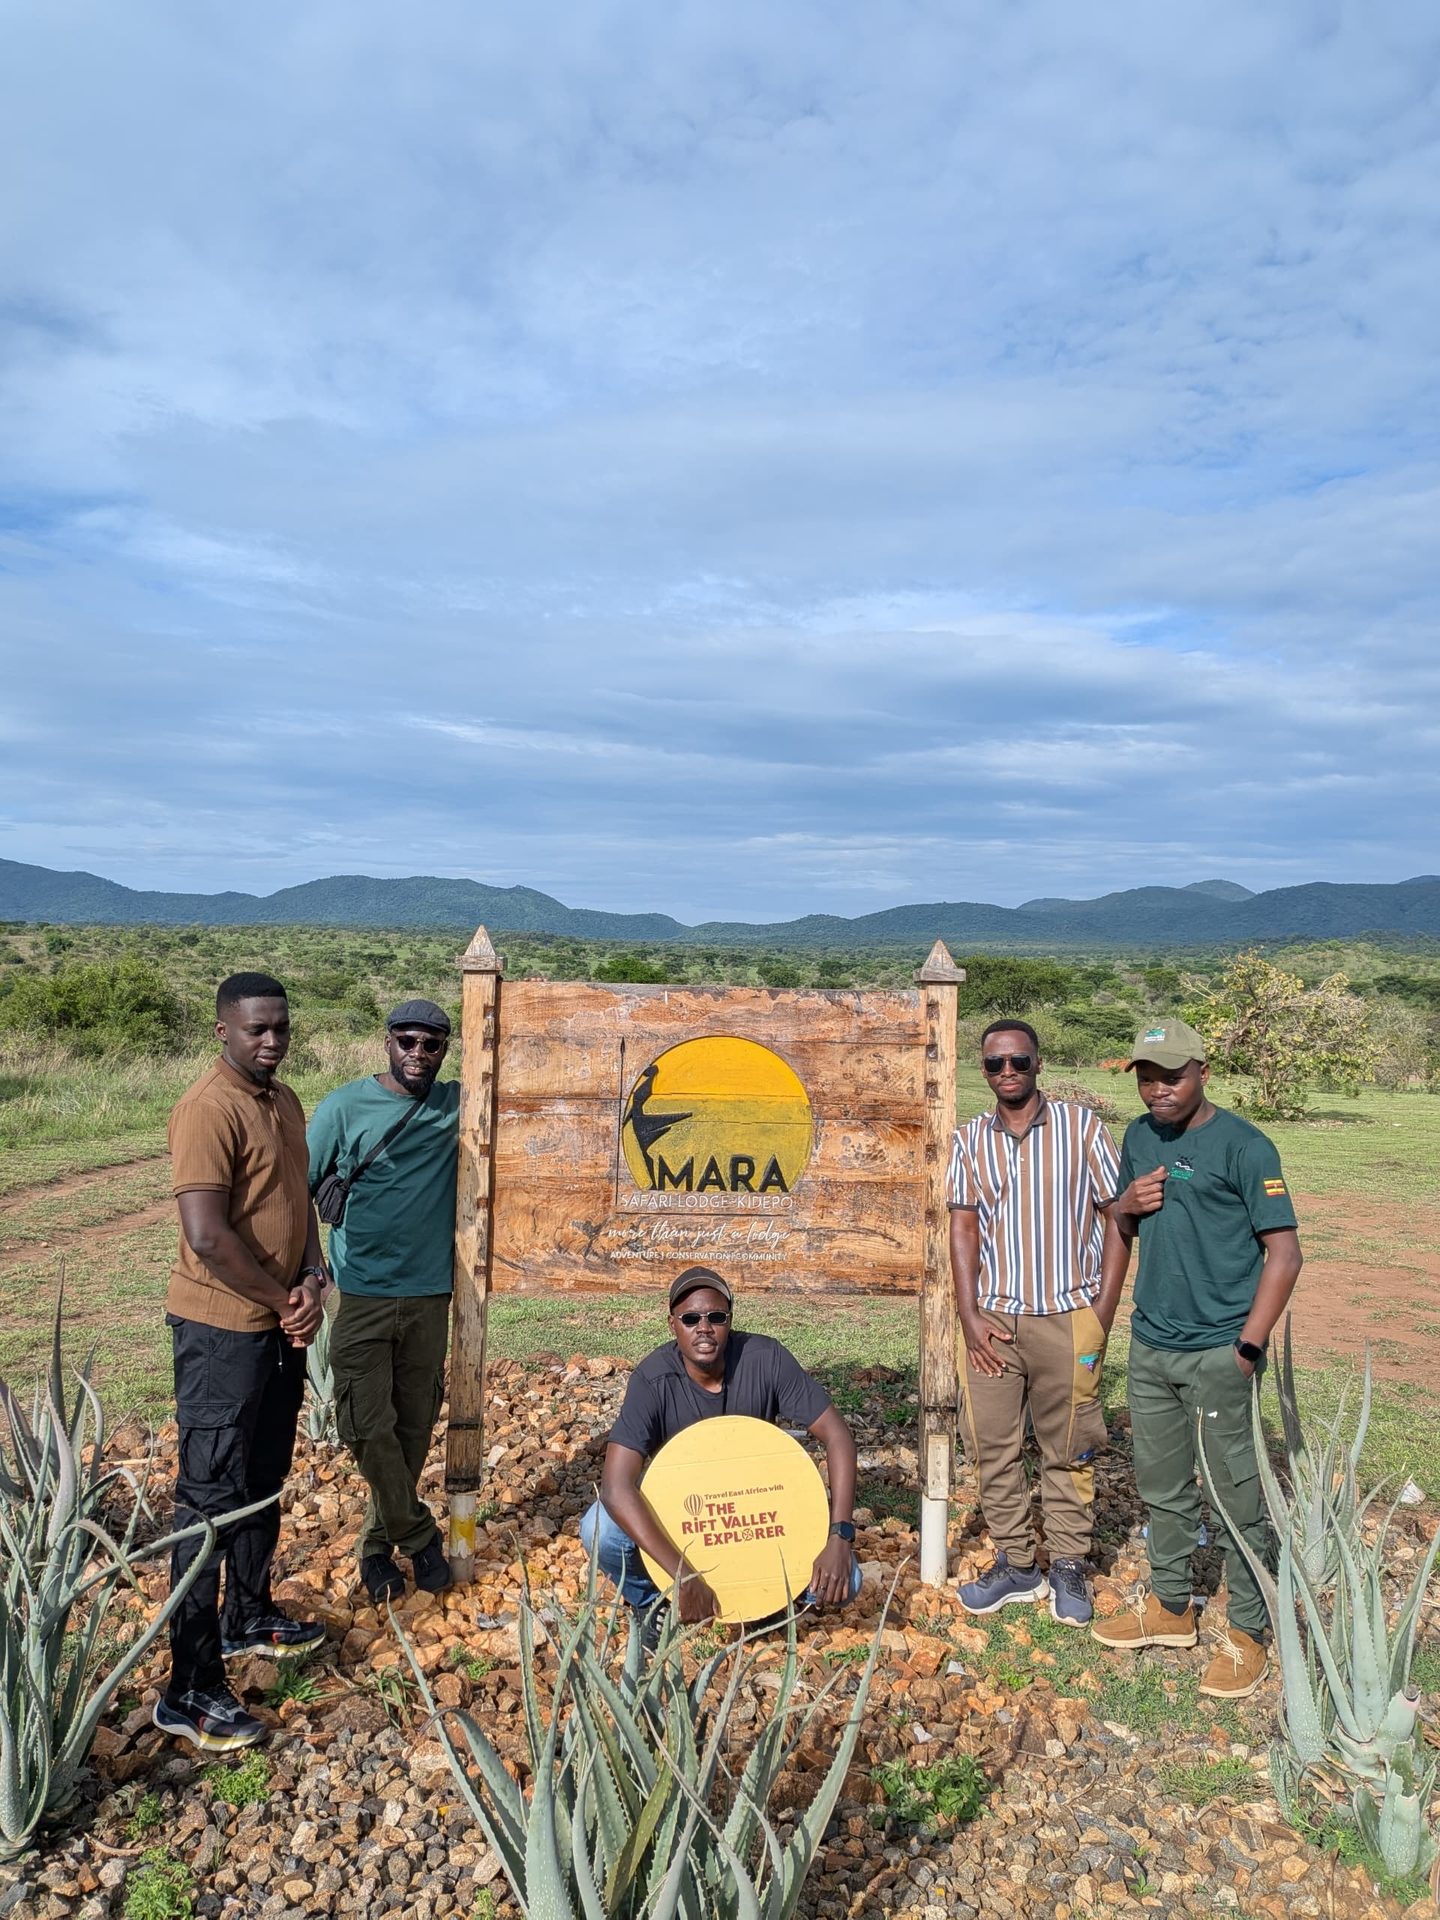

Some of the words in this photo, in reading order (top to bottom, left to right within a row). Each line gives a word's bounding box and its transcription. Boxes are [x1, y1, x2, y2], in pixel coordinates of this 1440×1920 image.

[621, 1194, 672, 1208] SAFARI
[678, 1195, 728, 1208] LODGE
[738, 1195, 793, 1209] KIDEPO
[608, 1228, 646, 1239] more
[651, 1220, 689, 1240] than
[691, 1222, 728, 1248] just
[731, 1230, 742, 1239] a
[747, 1220, 791, 1249] lodge
[610, 1251, 660, 1260] ADVENTURE
[666, 1251, 731, 1260] CONSERVATION
[735, 1252, 788, 1261] COMMUNITY
[704, 1491, 728, 1500] Travel
[729, 1489, 744, 1497] East
[745, 1487, 768, 1495] Africa
[705, 1502, 736, 1517] THE
[720, 1511, 778, 1529] VALLEY
[703, 1525, 785, 1546] EXPLORER
